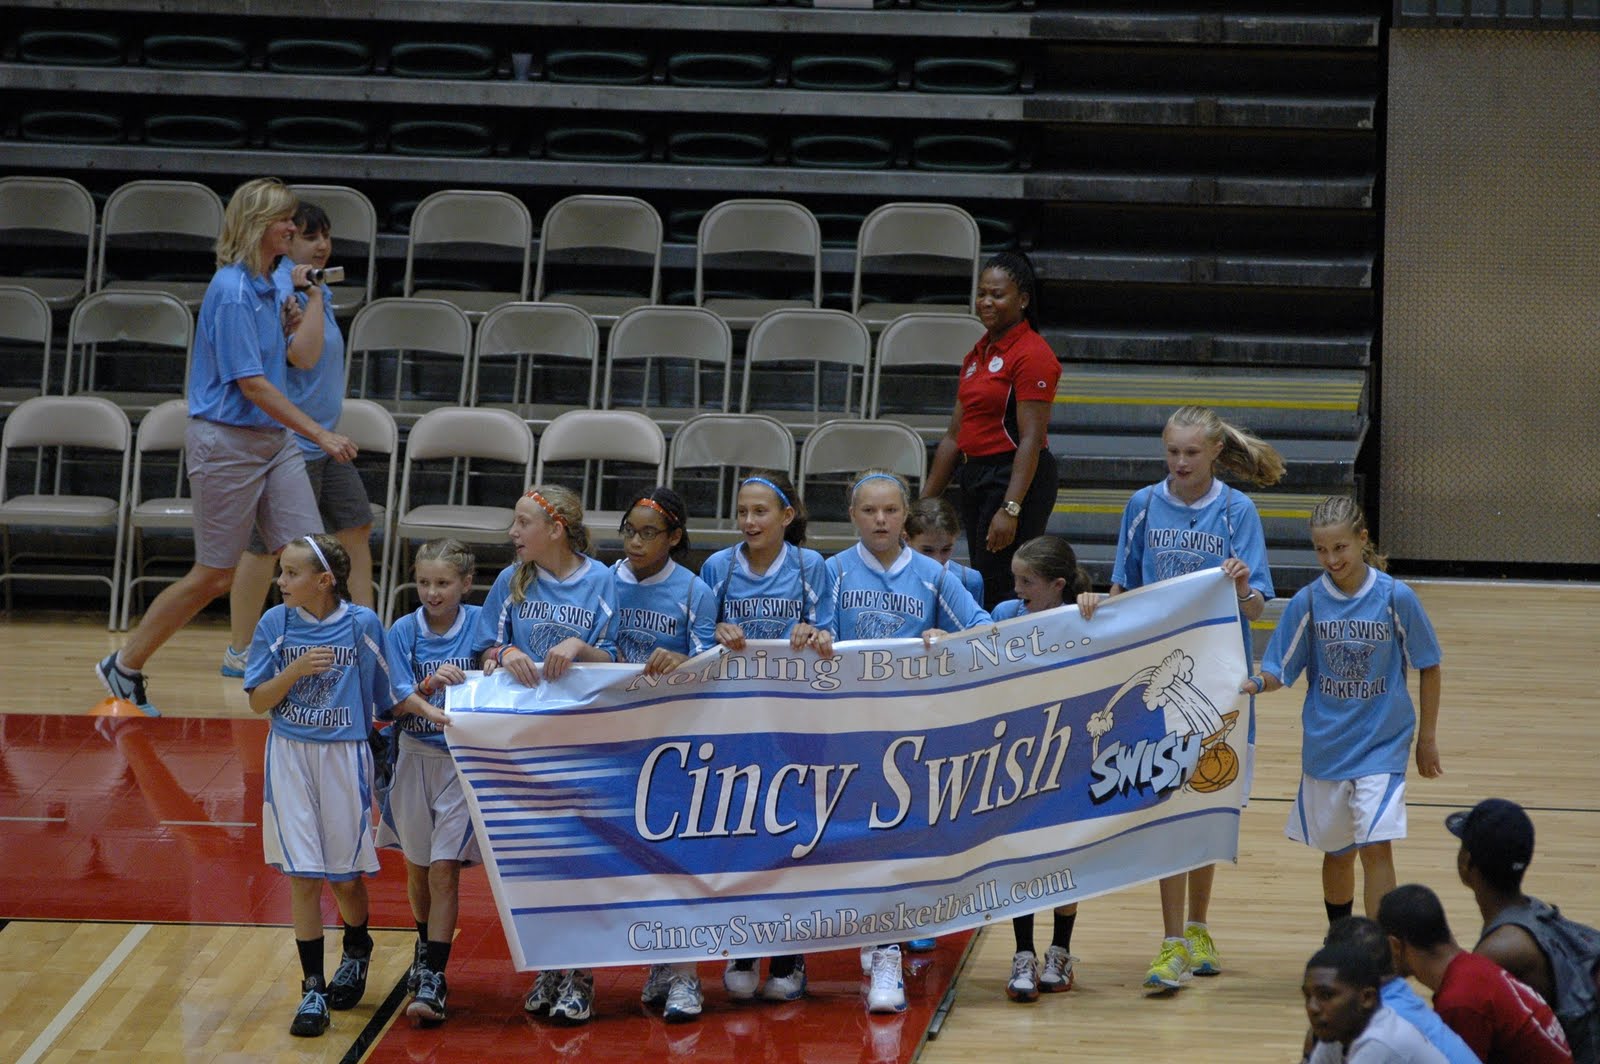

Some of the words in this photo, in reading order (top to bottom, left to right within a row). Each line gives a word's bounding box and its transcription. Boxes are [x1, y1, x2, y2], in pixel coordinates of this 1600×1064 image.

[1181, 529, 1224, 558] SWISH
[518, 601, 557, 621] CINCY
[558, 604, 594, 630] SWIS
[841, 589, 881, 611] CINCY
[881, 590, 924, 618] SWISH
[634, 608, 677, 636] SWISH
[857, 647, 956, 682] But
[967, 625, 1092, 673] Net...
[1319, 673, 1388, 701] BASKETBALL
[280, 698, 352, 728] BASKETBALL
[634, 740, 859, 860] Cincy
[868, 702, 1073, 831] Swish
[1089, 730, 1204, 804] SWISH
[628, 866, 1078, 955] CincySwishBasketball.com
